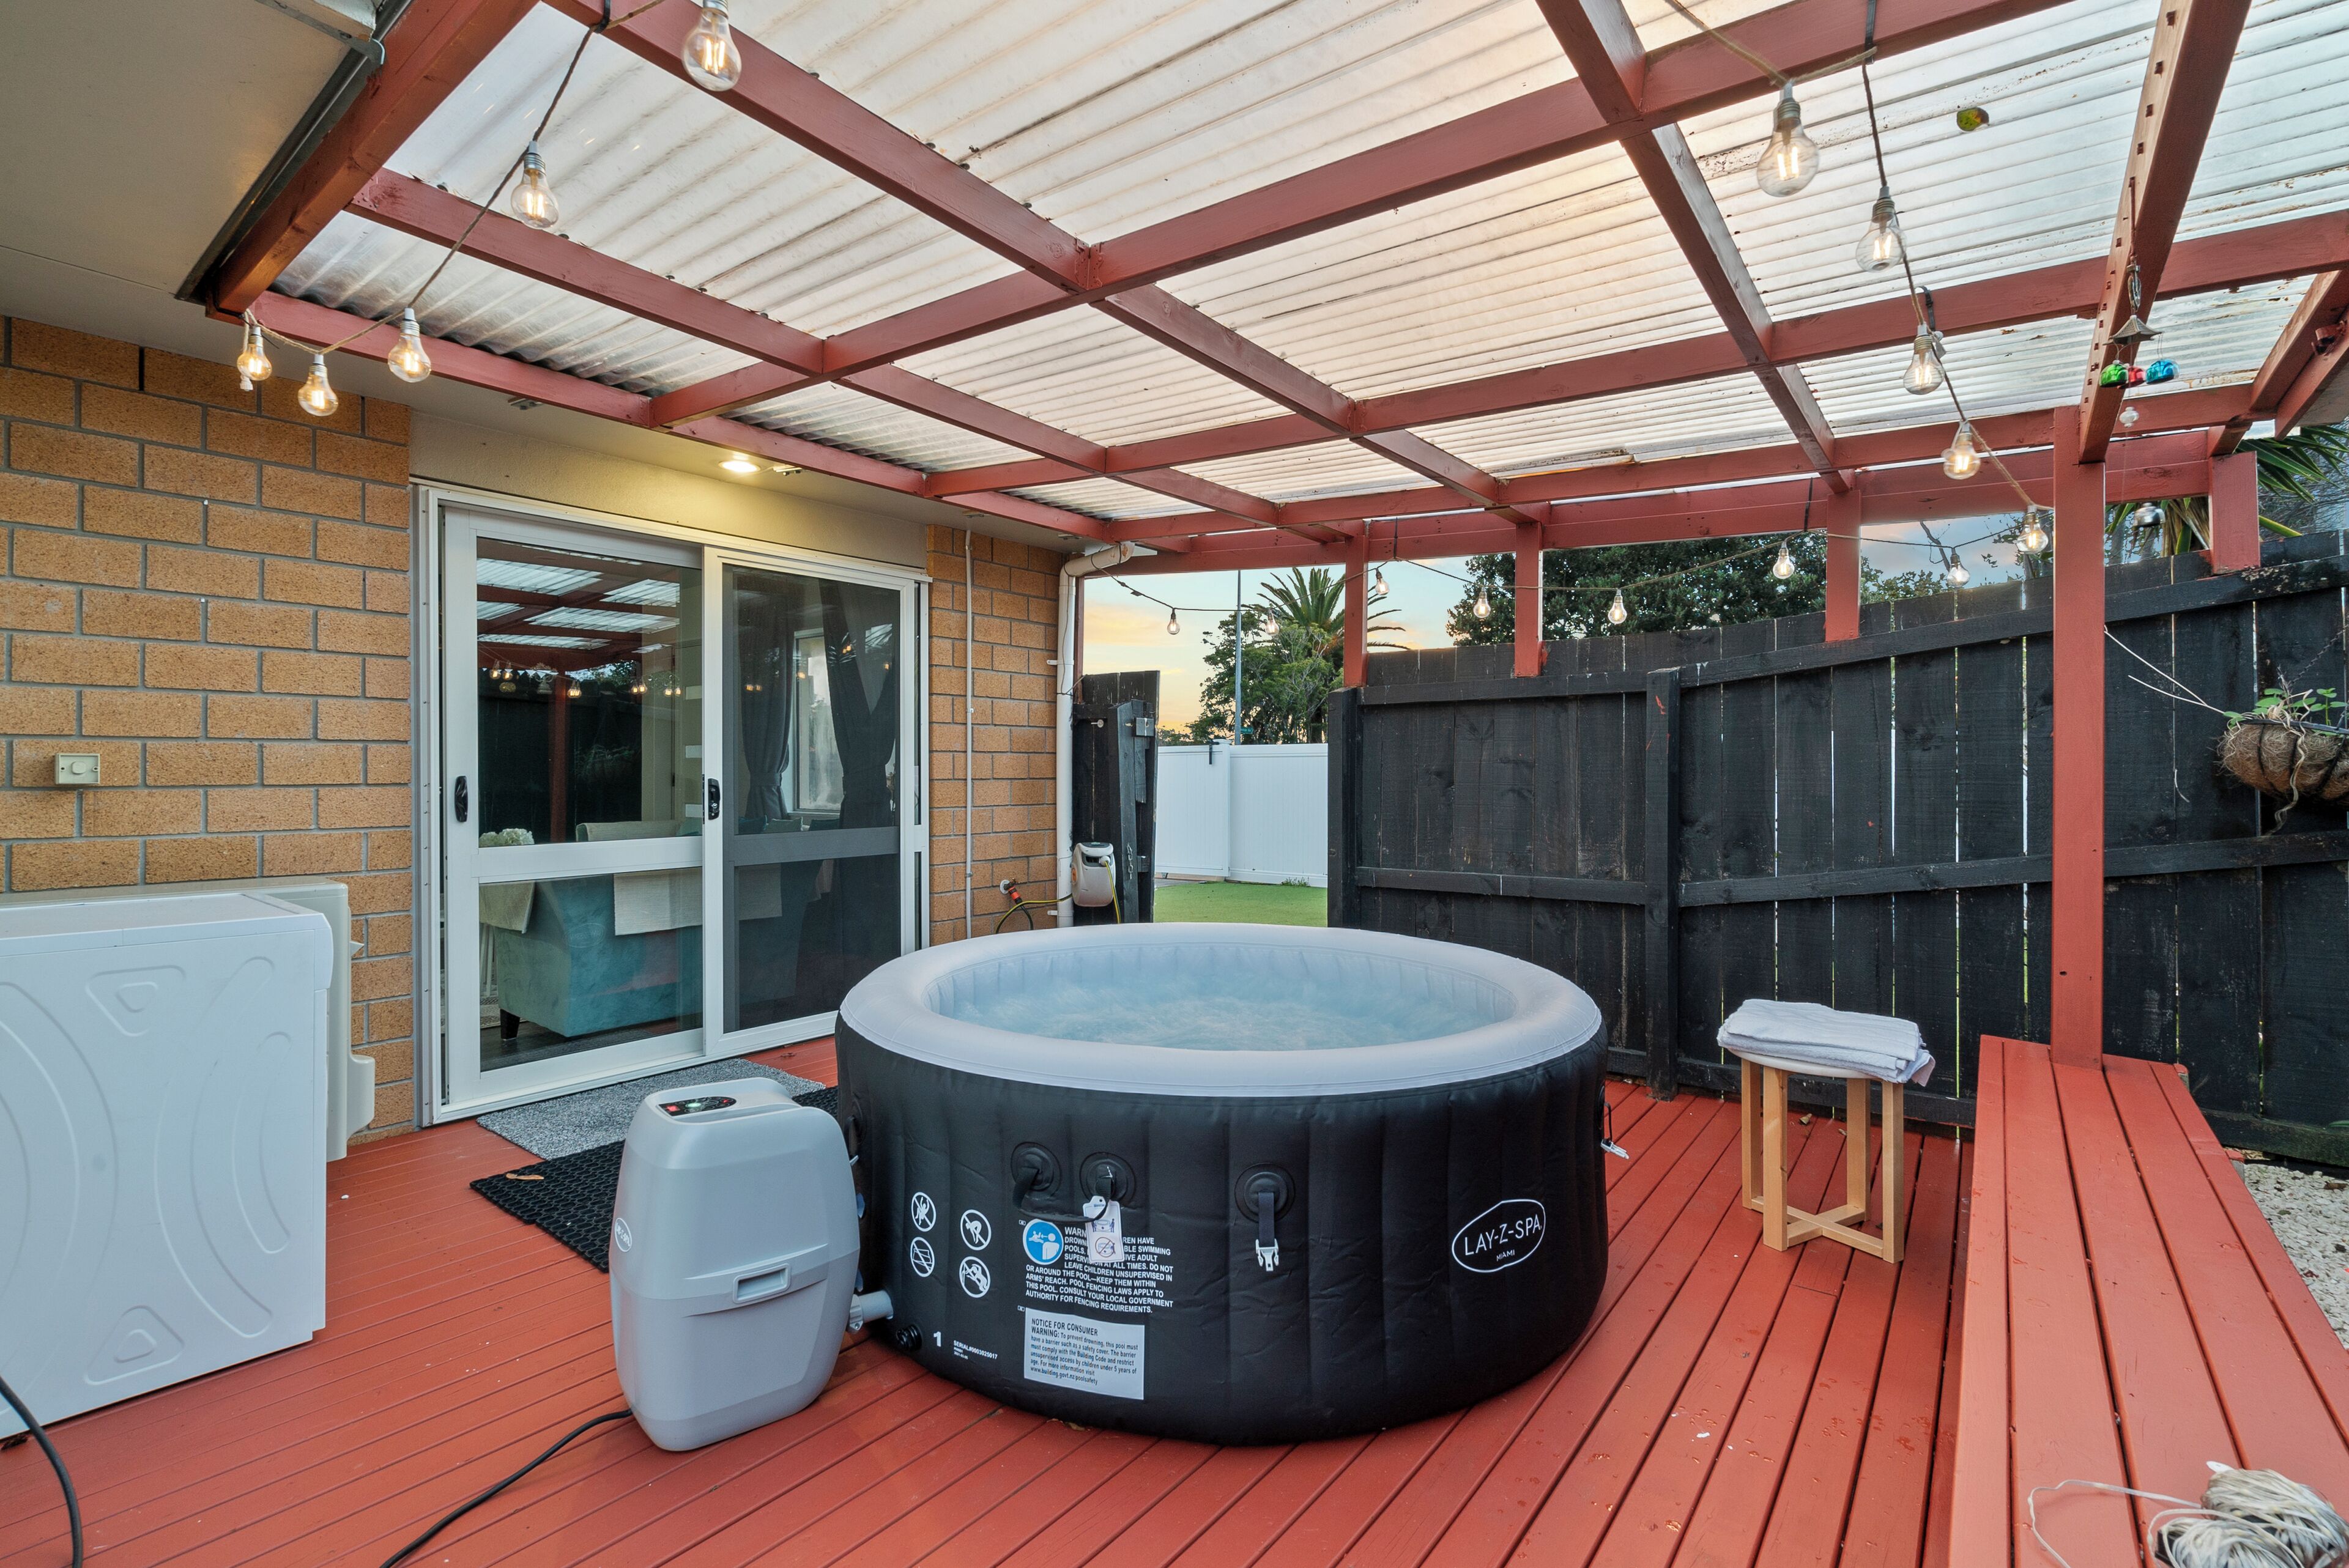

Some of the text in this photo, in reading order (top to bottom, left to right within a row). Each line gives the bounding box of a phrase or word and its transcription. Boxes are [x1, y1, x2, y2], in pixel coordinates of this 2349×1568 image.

[1064, 1227, 1086, 1238] WARN
[1464, 1213, 1541, 1256] LAY-Z-SPA
[1064, 1237, 1087, 1246] DROWN
[1138, 1246, 1171, 1256] SWIMMING
[1064, 1245, 1086, 1254] POOLS.
[1496, 1249, 1515, 1261] MIAMI
[1035, 1266, 1061, 1276] AROUND
[1064, 1262, 1083, 1271] LEAVE
[1084, 1265, 1114, 1276] CHILDREN
[1115, 1270, 1165, 1280] UNSUPERVISED
[1025, 1273, 1044, 1282] ARMS'
[1045, 1276, 1068, 1285] REACH.
[1069, 1279, 1085, 1288] POOL
[1086, 1282, 1112, 1293] FENCING
[1025, 1290, 1059, 1301] AUTHORITY
[1074, 1296, 1099, 1308] FENCING
[1100, 1302, 1153, 1313] REQUIREMENTS.
[1026, 1281, 1173, 1307] THIS POOL. CONSULT YOUR LOCAL GOVERNMENT
[1031, 1318, 1098, 1336] NOTICE FOR CONSUMER
[1031, 1326, 1059, 1338] WARNING:
[933, 1331, 941, 1347] 1
[1031, 1352, 1058, 1361] unsupervised
[1082, 1359, 1099, 1369] children
[1042, 1346, 1057, 1355] comply
[1077, 1351, 1094, 1361] Building
[1060, 1363, 1085, 1374] information
